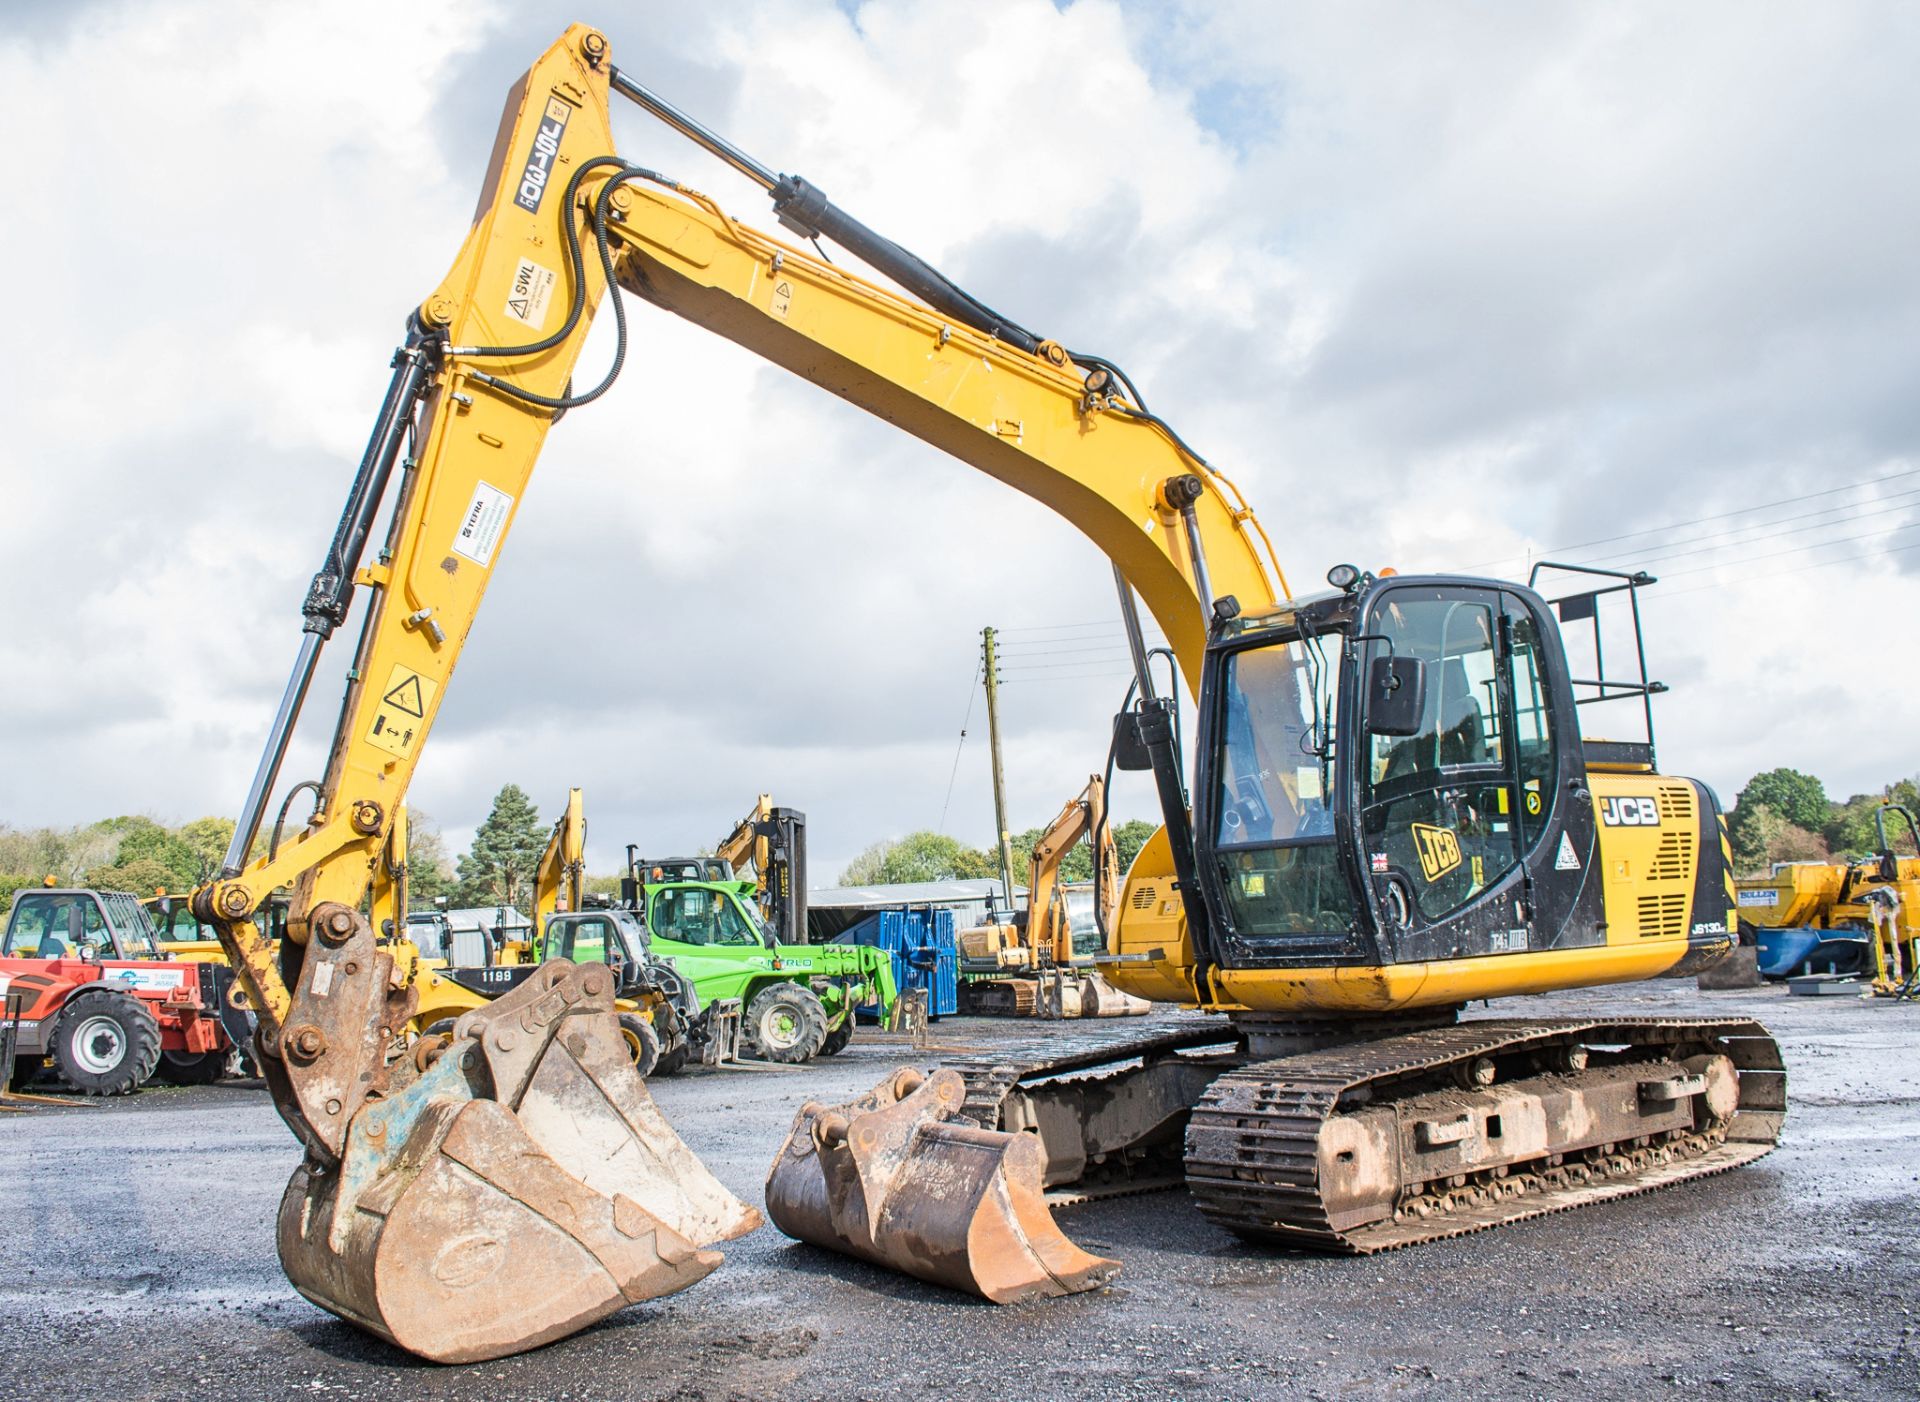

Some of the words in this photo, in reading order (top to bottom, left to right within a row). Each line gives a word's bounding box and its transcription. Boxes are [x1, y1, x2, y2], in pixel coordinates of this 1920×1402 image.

[521, 123, 561, 202] JS130
[515, 265, 535, 296] SWL
[1603, 798, 1659, 825] JCB
[1420, 829, 1459, 875] JCB
[1692, 922, 1720, 935] JS130
